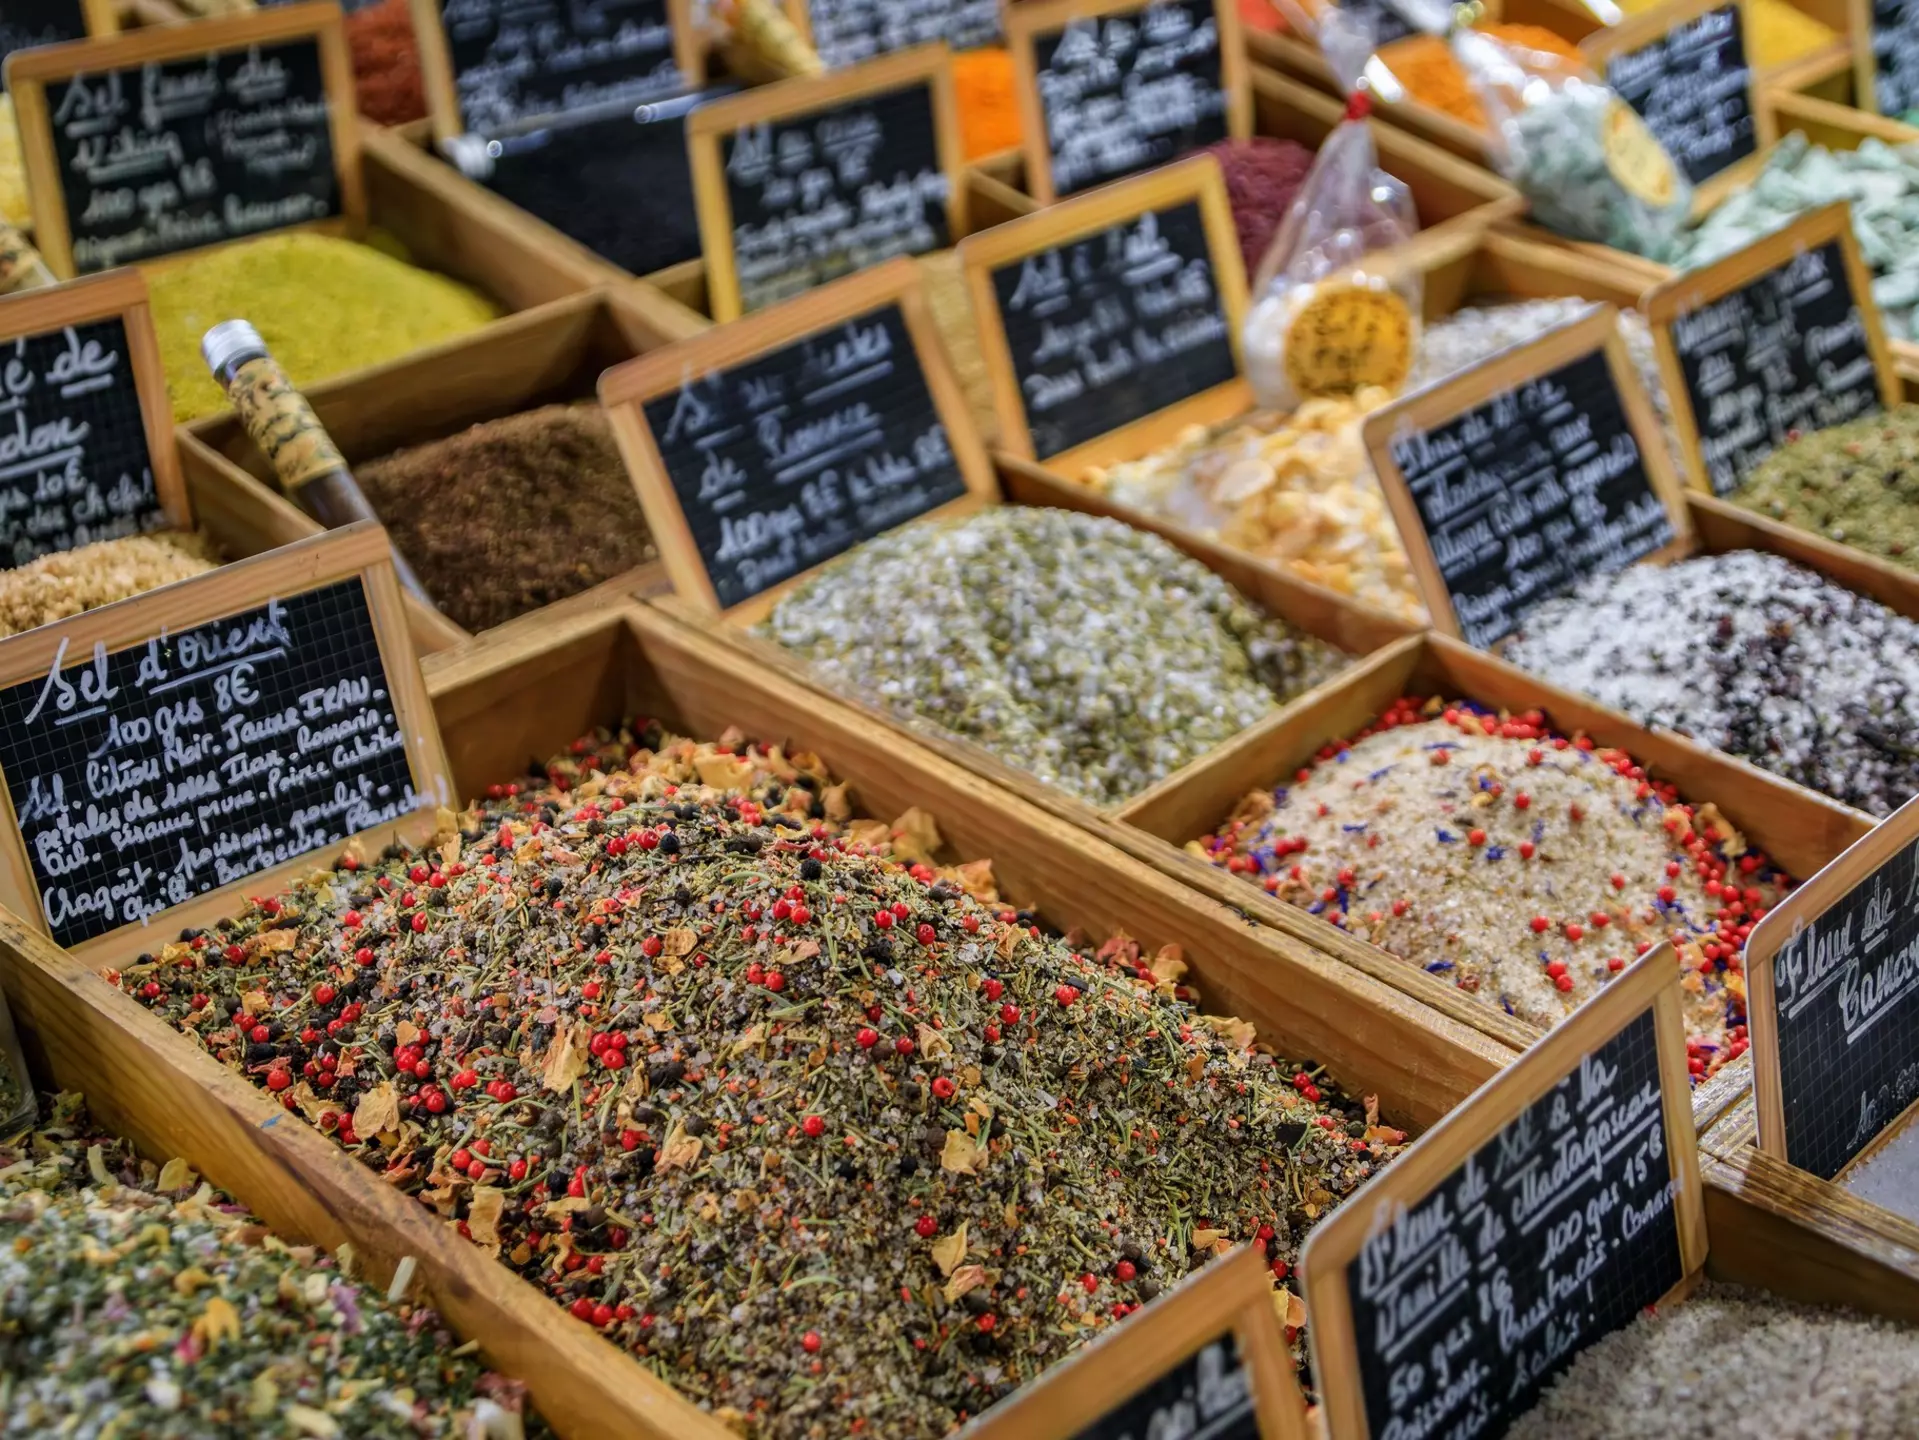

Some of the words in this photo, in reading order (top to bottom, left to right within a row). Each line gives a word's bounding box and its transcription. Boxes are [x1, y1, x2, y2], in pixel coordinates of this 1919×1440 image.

[46, 325, 118, 384] de
[698, 450, 747, 499] de
[24, 636, 119, 725] Sel
[88, 714, 150, 759] 100
[155, 697, 204, 749] grs
[214, 662, 259, 712] 8€
[221, 706, 301, 752] Jaune
[124, 789, 158, 823] de
[1775, 914, 1855, 1015] Fleur
[1861, 875, 1897, 942] de
[1456, 1154, 1490, 1210] de
[1577, 1052, 1618, 1112] la
[1478, 1201, 1506, 1255] de
[1512, 1081, 1662, 1224] Madagascar
[1388, 1362, 1425, 1411] 50
[1431, 1316, 1473, 1388] grs
[1540, 1213, 1584, 1272] 100
[1586, 1184, 1621, 1241] grs
[1623, 1124, 1664, 1189] 15€
